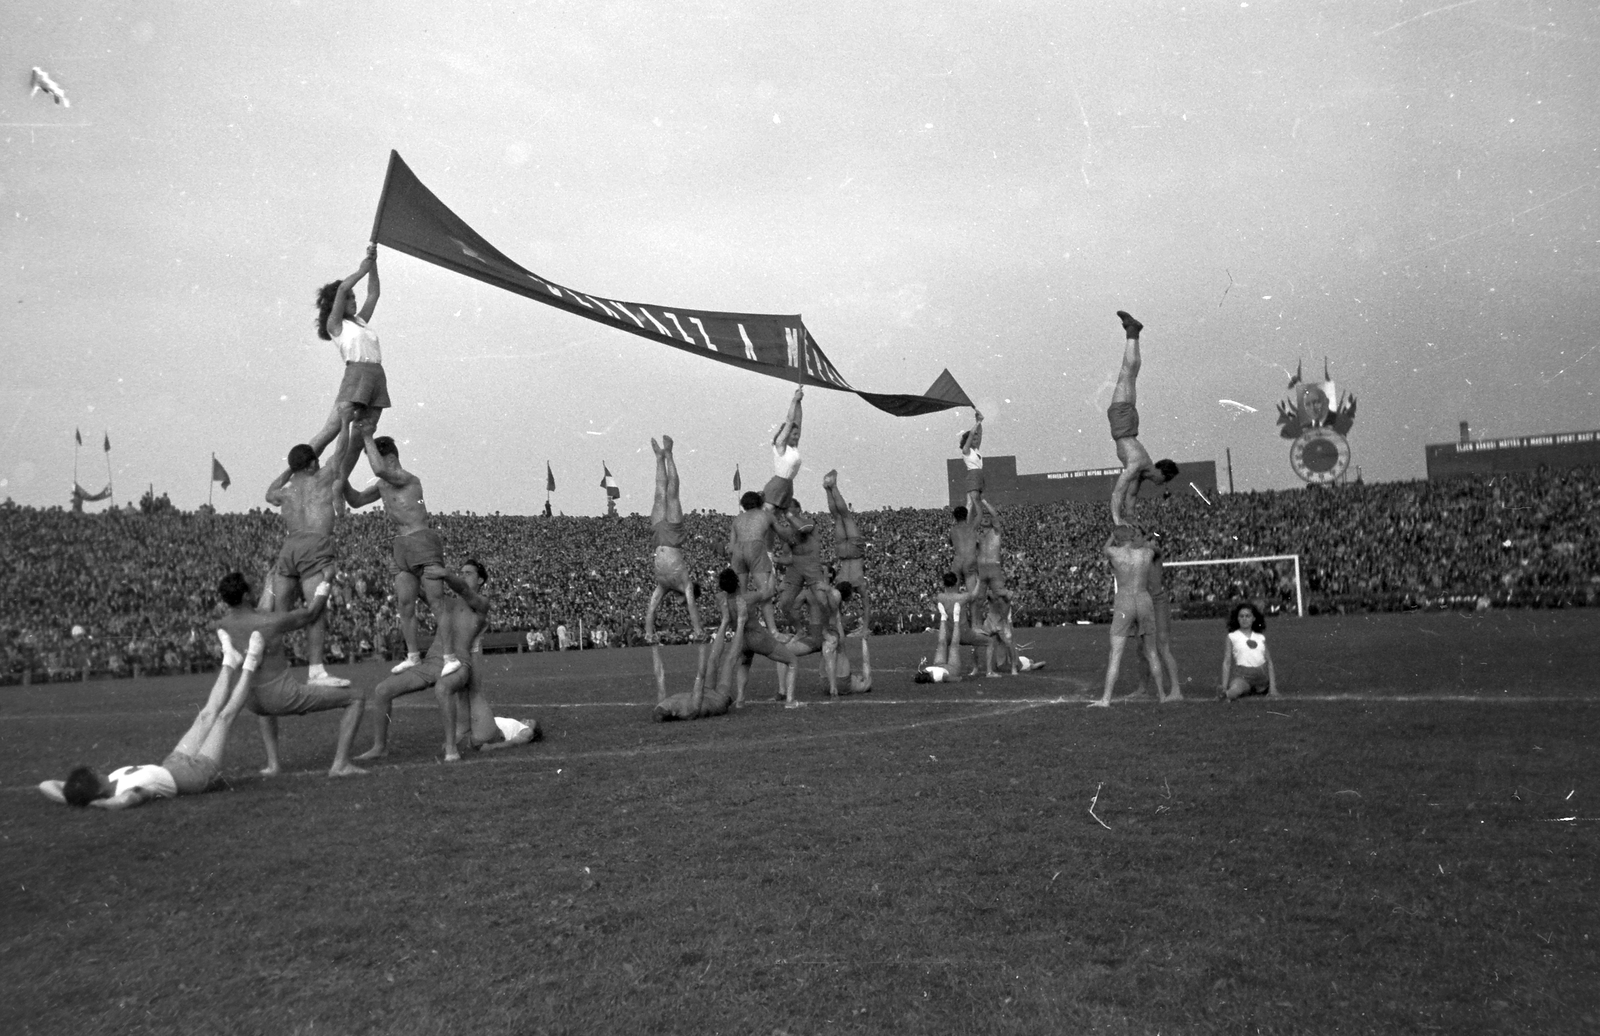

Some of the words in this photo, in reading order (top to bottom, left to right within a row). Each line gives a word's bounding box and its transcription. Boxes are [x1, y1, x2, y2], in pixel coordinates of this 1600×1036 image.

[738, 324, 758, 361] A
[1530, 436, 1553, 446] MAGYAR
[1556, 434, 1575, 444] SPORT
